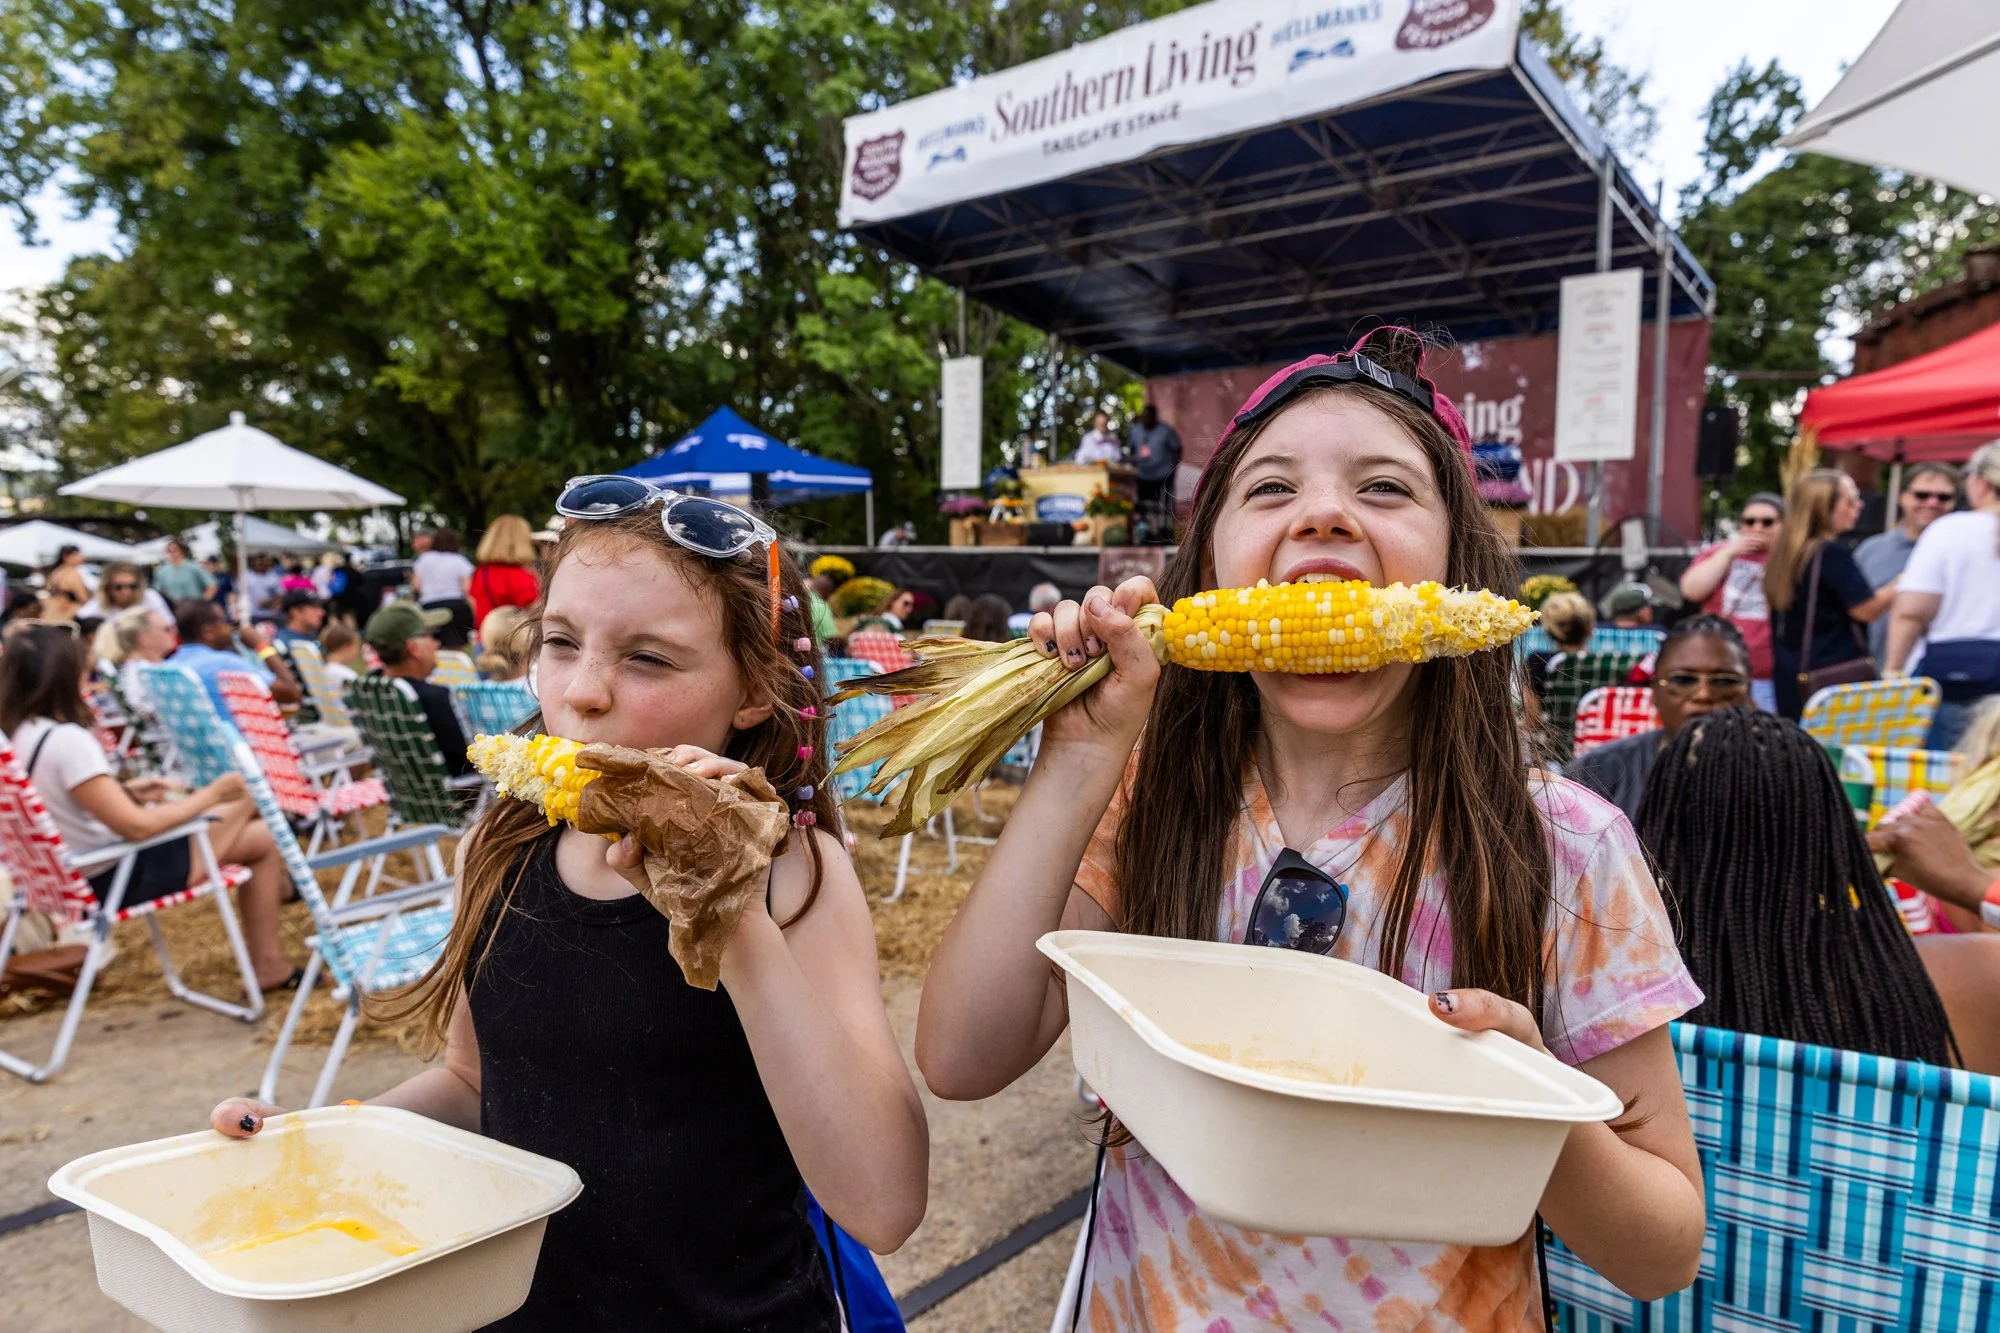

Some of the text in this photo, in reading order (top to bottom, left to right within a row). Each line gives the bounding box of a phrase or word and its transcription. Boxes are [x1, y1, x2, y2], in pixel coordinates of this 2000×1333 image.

[990, 21, 1264, 144] Southern Living
[1043, 101, 1181, 157] TAILGATE STAGE
